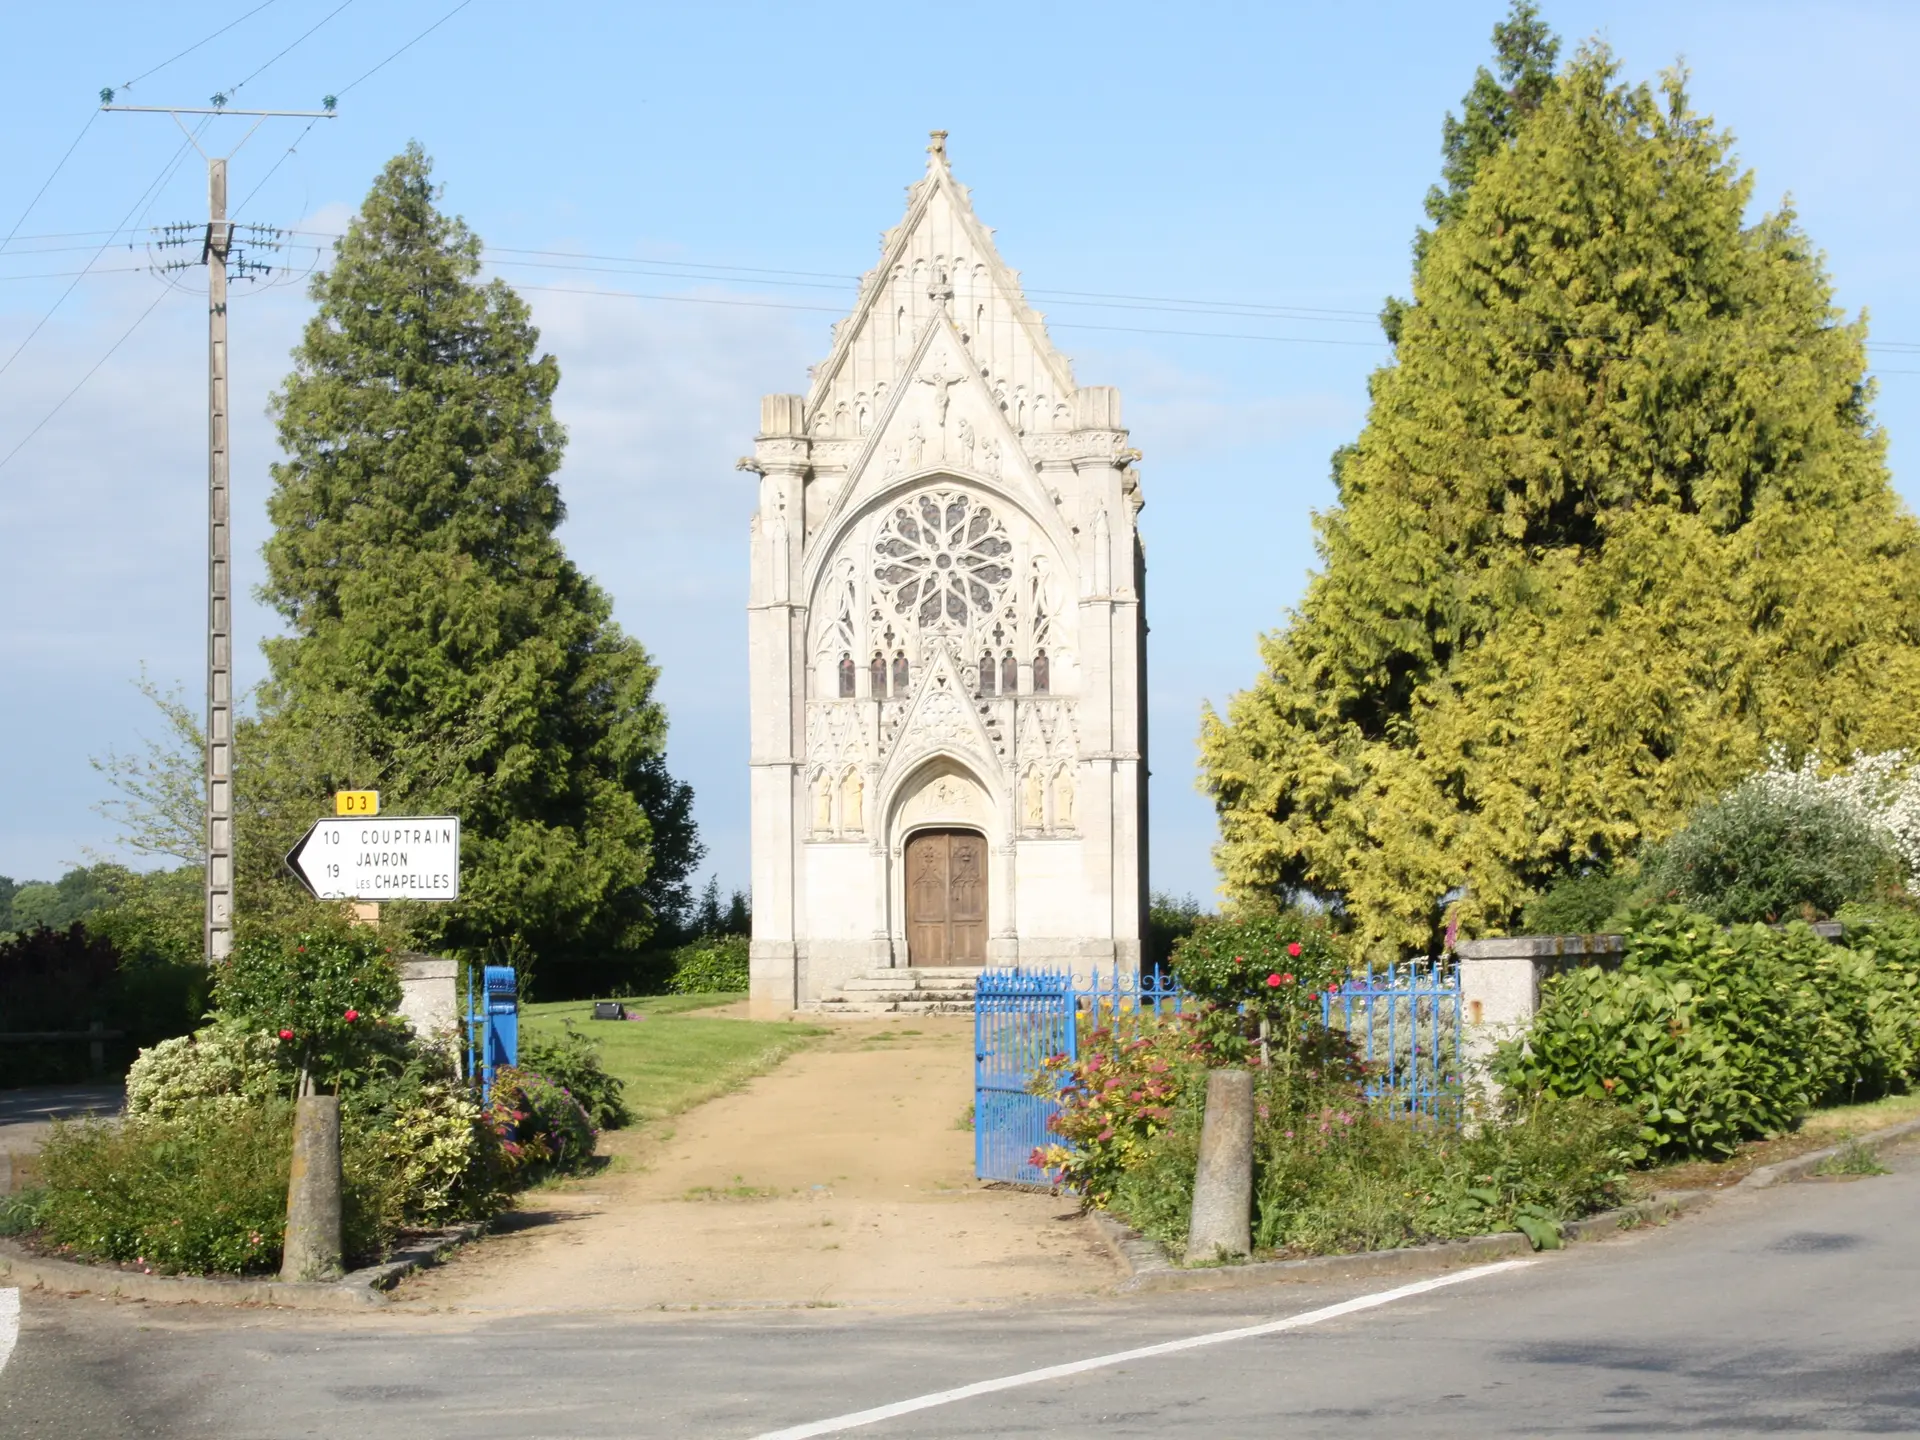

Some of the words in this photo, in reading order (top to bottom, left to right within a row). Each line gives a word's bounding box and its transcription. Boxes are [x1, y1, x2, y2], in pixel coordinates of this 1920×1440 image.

[324, 831, 340, 845] 10
[361, 829, 451, 845] COUPTRAIN
[356, 852, 408, 867] JAVRON
[326, 864, 340, 878] 19
[356, 879, 371, 889] LES
[374, 874, 449, 889] CHAPELLES
